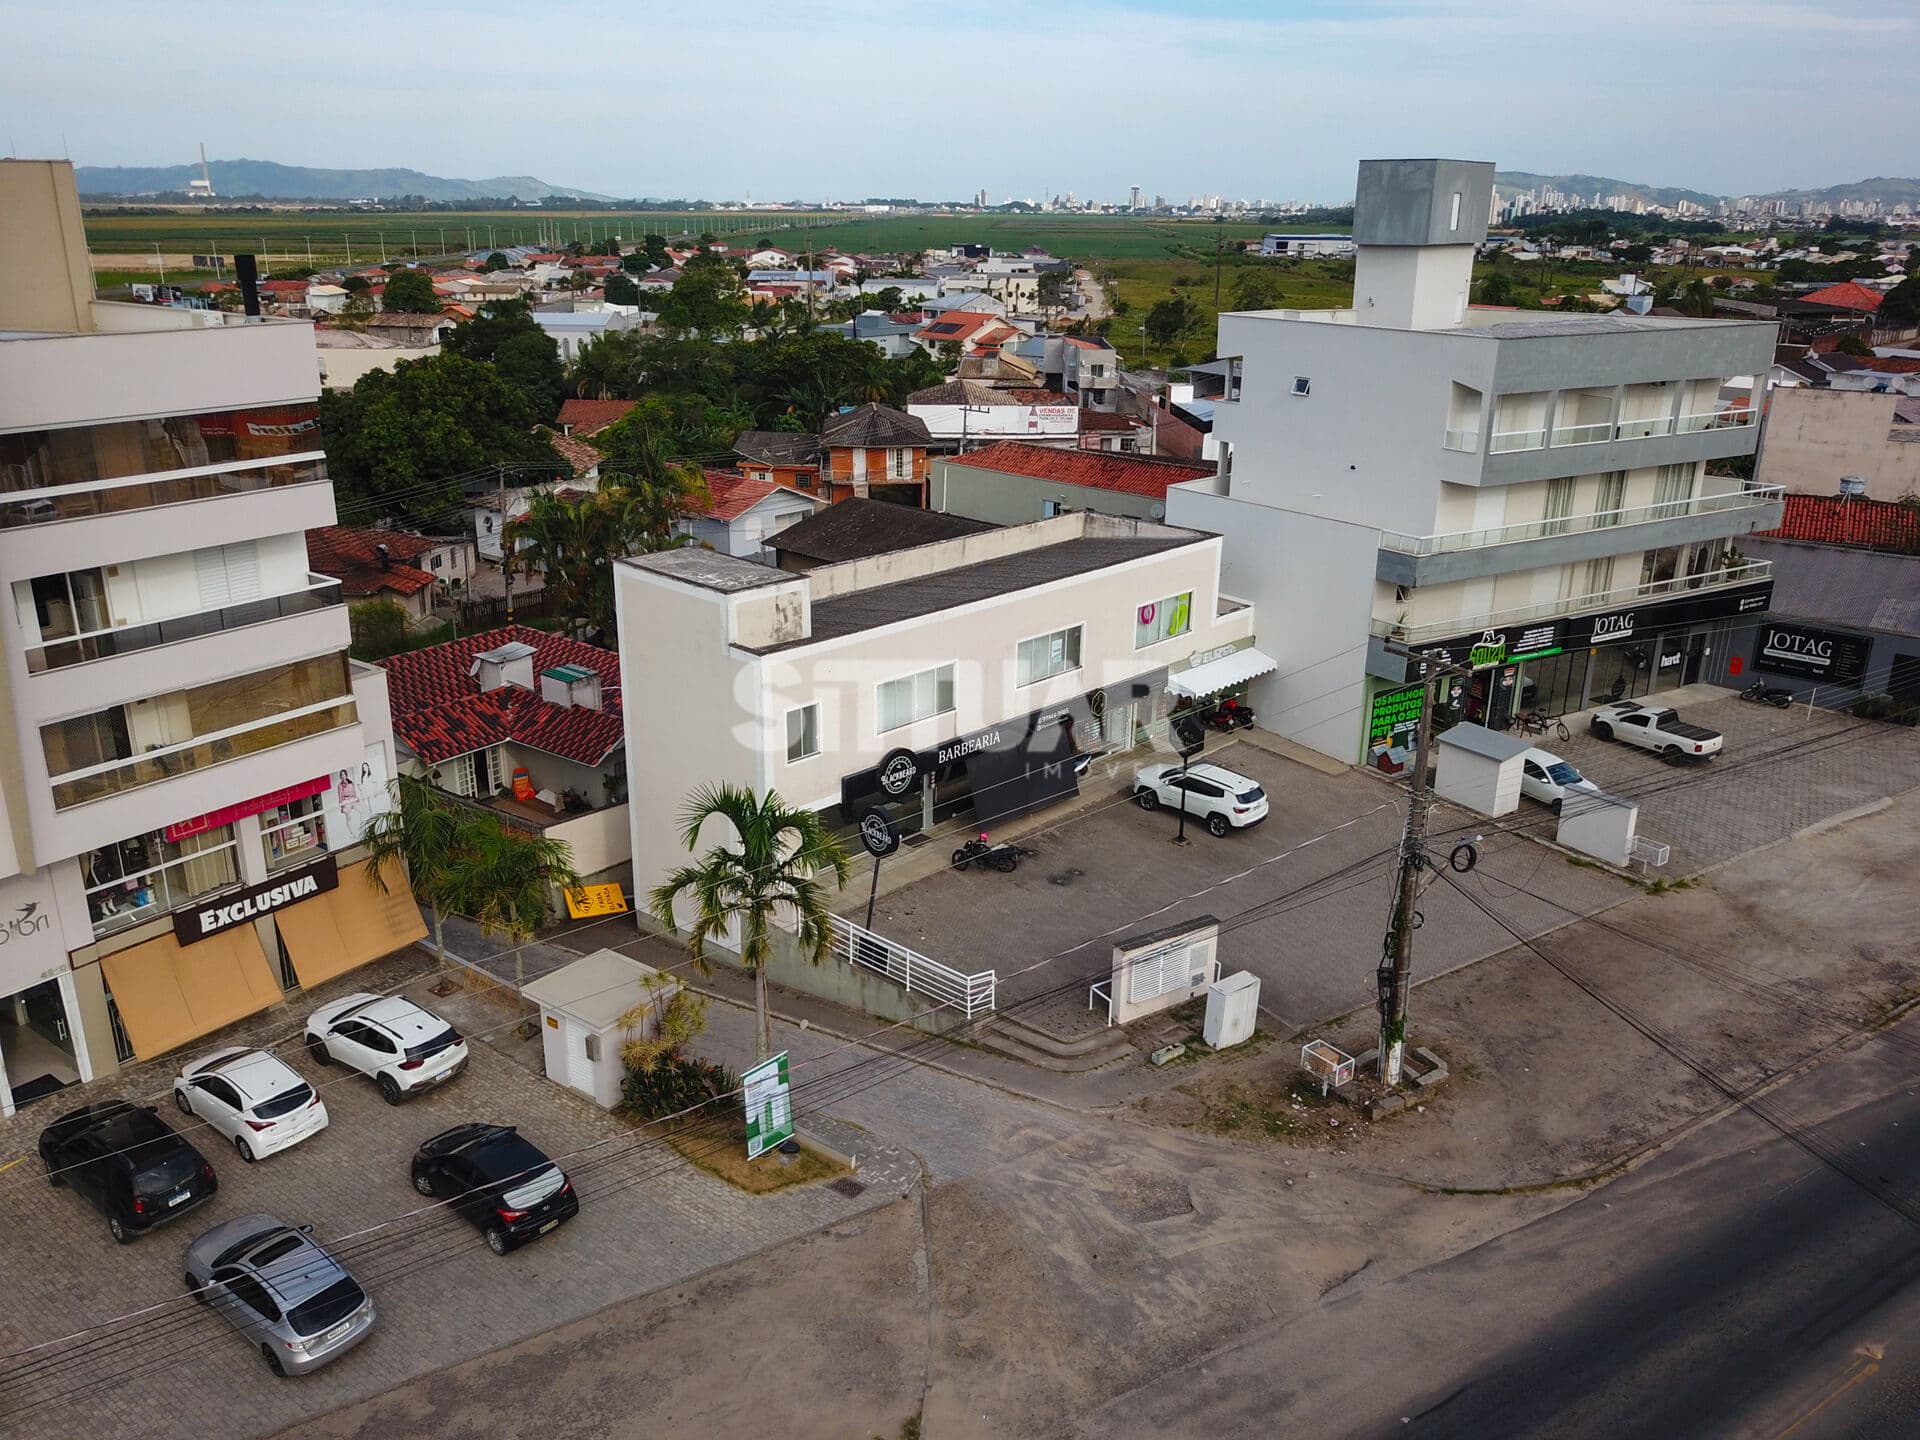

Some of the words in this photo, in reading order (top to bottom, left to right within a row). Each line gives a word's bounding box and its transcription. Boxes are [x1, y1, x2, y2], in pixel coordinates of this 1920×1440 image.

[1592, 613, 1634, 637] JOTAG
[1766, 629, 1833, 657] JOTAG
[1373, 698, 1423, 717] PRODUTOS
[1374, 695, 1387, 707] OS
[1372, 716, 1398, 728] PARA
[1398, 712, 1406, 721] O
[937, 731, 1001, 764] BARBEARIA
[199, 875, 319, 934] EXCLUSIVA
